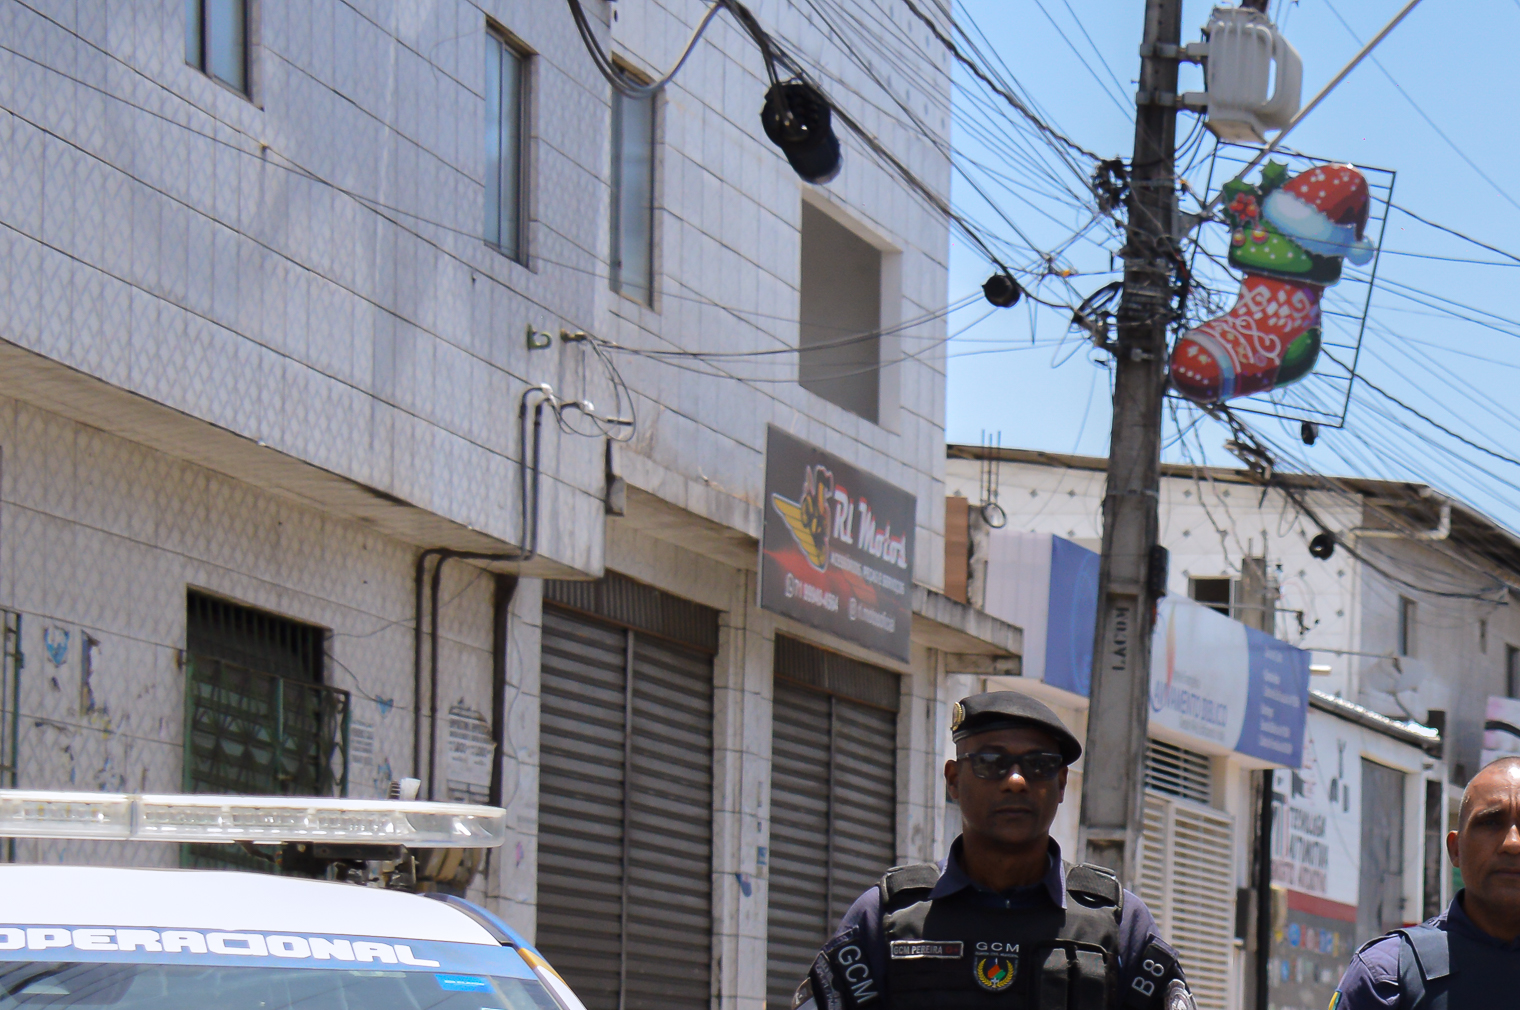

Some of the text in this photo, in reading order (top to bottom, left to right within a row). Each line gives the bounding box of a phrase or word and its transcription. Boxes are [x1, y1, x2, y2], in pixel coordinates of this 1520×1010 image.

[893, 945, 910, 955] GCM
[911, 945, 943, 955] PEREIRA
[976, 941, 1020, 953] GCM
[838, 945, 879, 1004] GCM
[1131, 959, 1165, 997] B8
